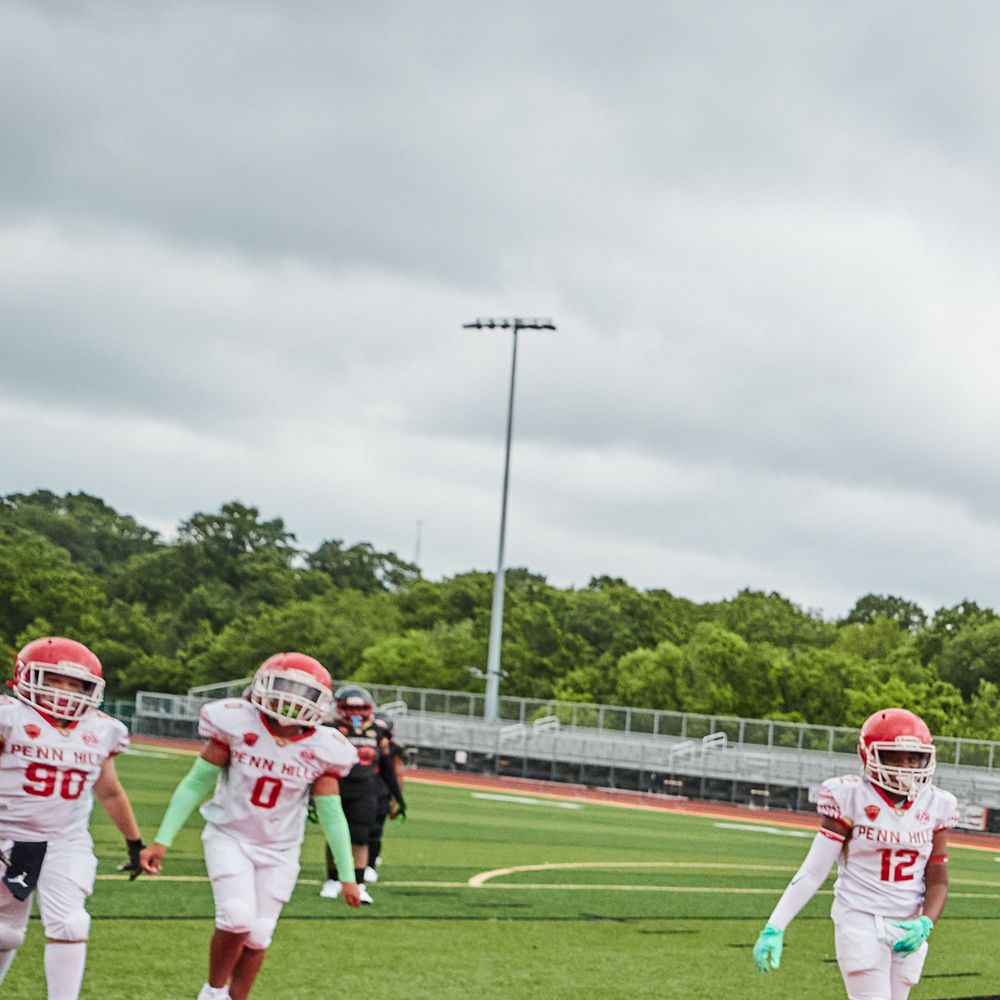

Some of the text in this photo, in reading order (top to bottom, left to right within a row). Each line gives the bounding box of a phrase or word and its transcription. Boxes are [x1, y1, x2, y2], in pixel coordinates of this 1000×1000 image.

[11, 744, 64, 761] PENN
[230, 749, 275, 772] PENN
[22, 762, 89, 800] 90
[251, 775, 283, 809] 0
[858, 825, 900, 843] PENN
[876, 849, 919, 882] 12
